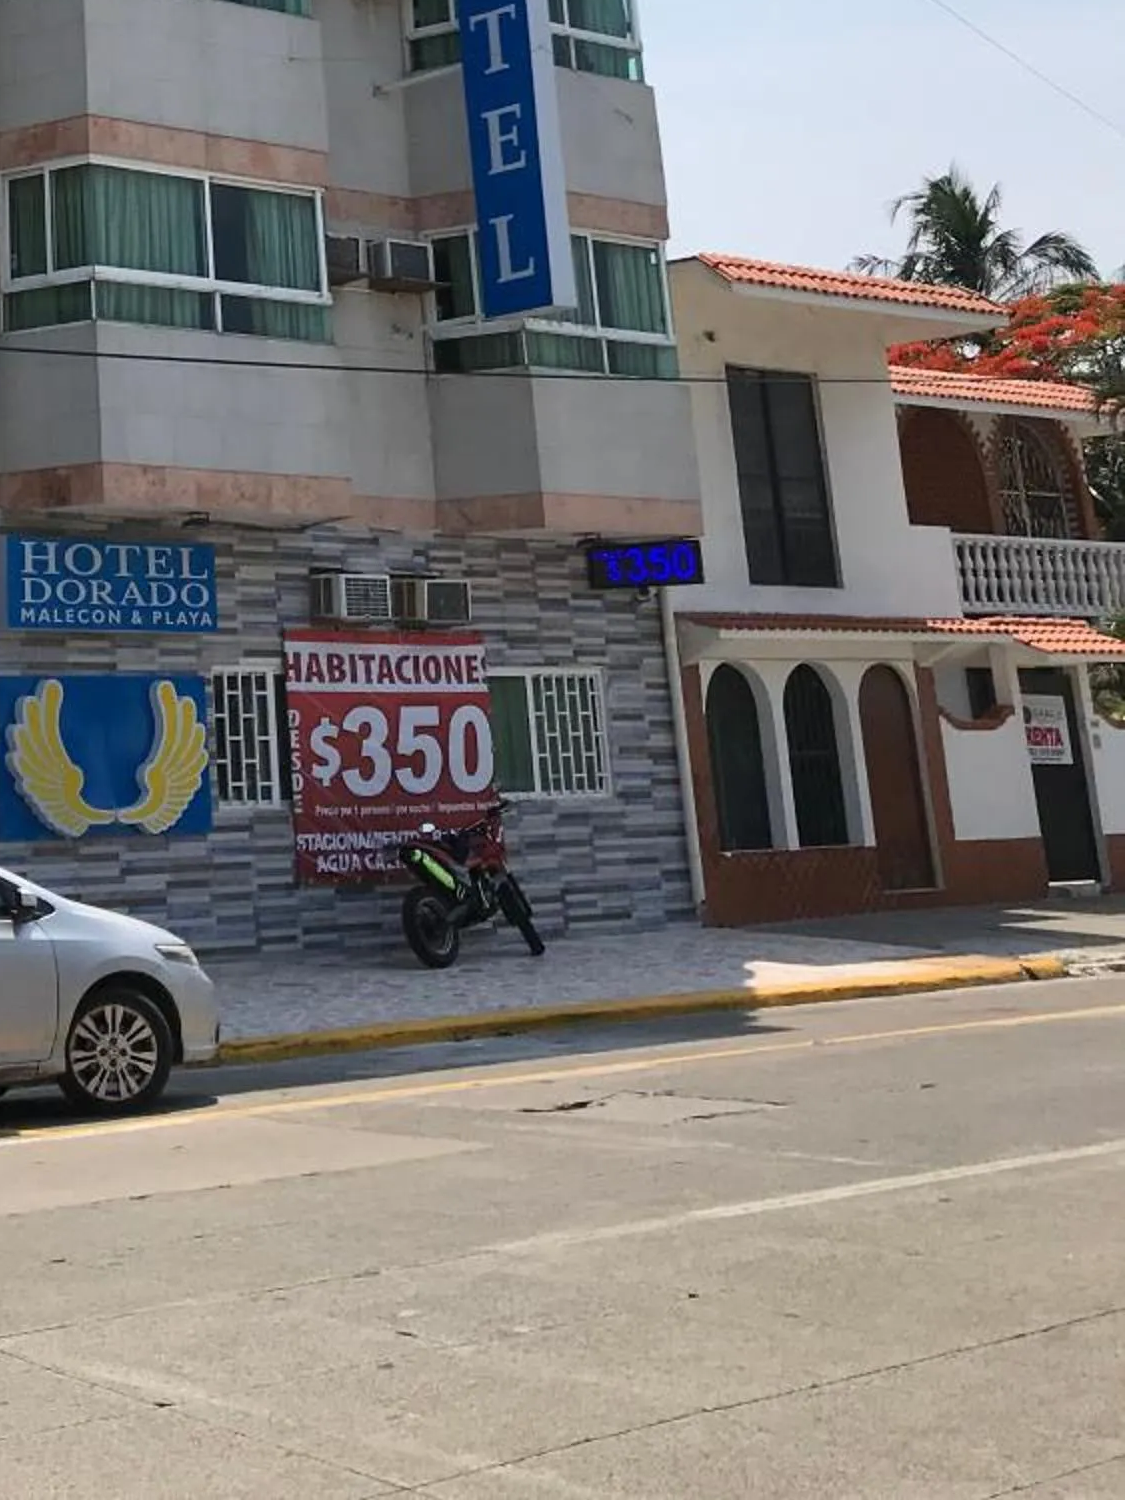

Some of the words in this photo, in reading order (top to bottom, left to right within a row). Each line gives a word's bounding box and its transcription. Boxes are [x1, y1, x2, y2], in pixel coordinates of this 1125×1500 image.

[20, 541, 208, 579] HOTEL
[21, 577, 210, 608] DORADO
[20, 608, 121, 624] MALECON
[130, 609, 143, 625] &
[152, 611, 213, 626] PLAYA
[287, 709, 304, 813] DESDE
[310, 704, 494, 798] $350
[316, 853, 363, 873] AGUA
